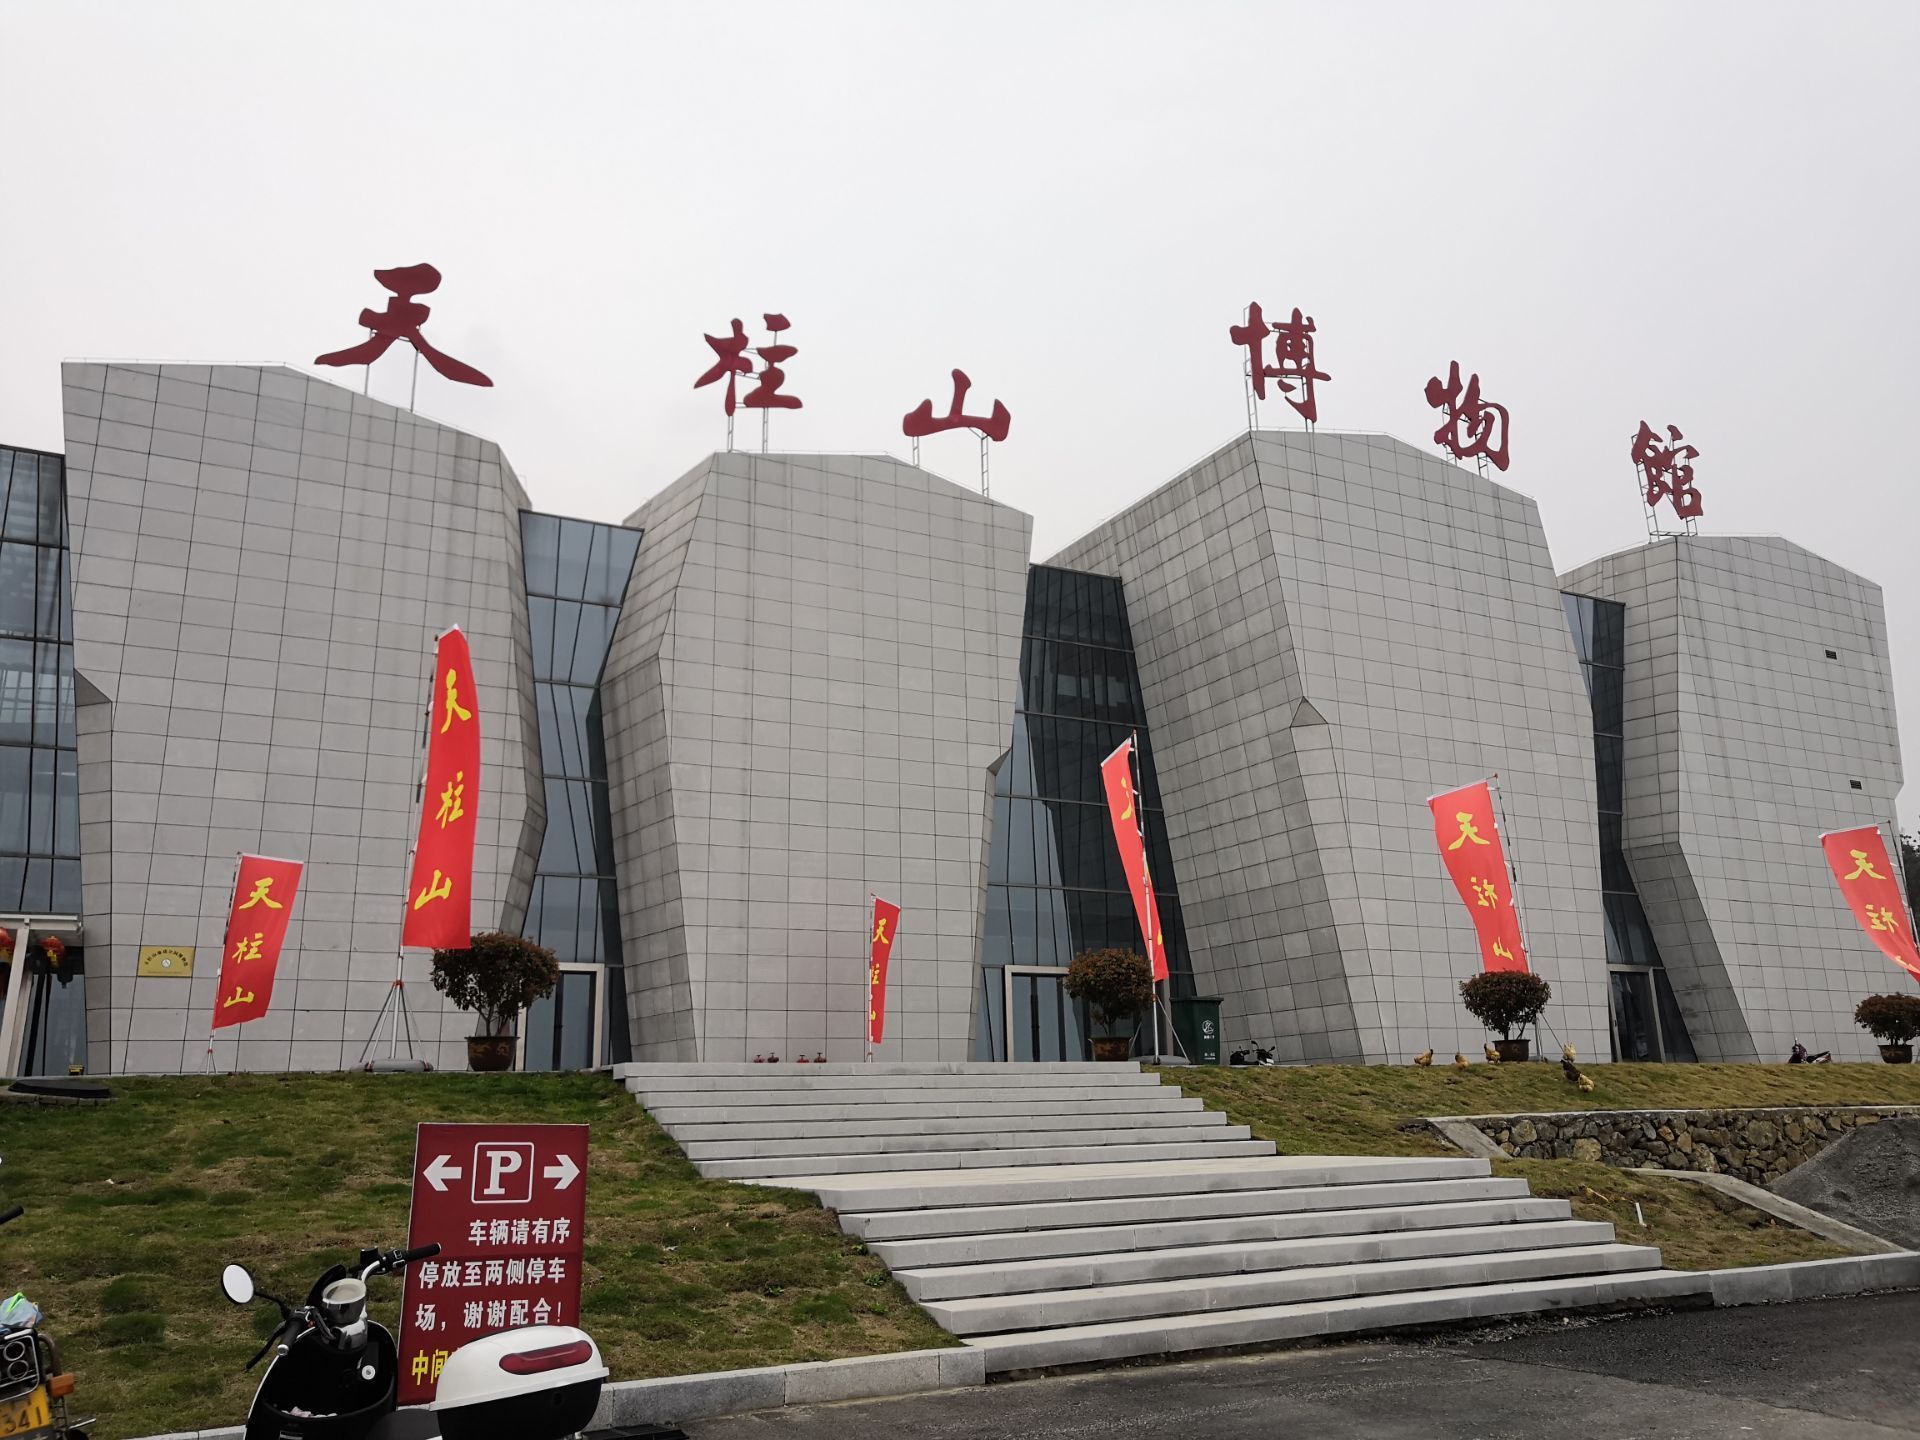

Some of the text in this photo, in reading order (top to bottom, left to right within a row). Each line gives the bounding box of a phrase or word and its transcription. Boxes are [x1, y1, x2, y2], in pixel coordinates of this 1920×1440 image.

[414, 668, 472, 911] 天柱山
[224, 877, 283, 1008] 天柱山
[483, 1150, 523, 1195] P
[468, 1217, 571, 1246] 车辆请有序
[418, 1257, 566, 1289] 停放至两侧停车
